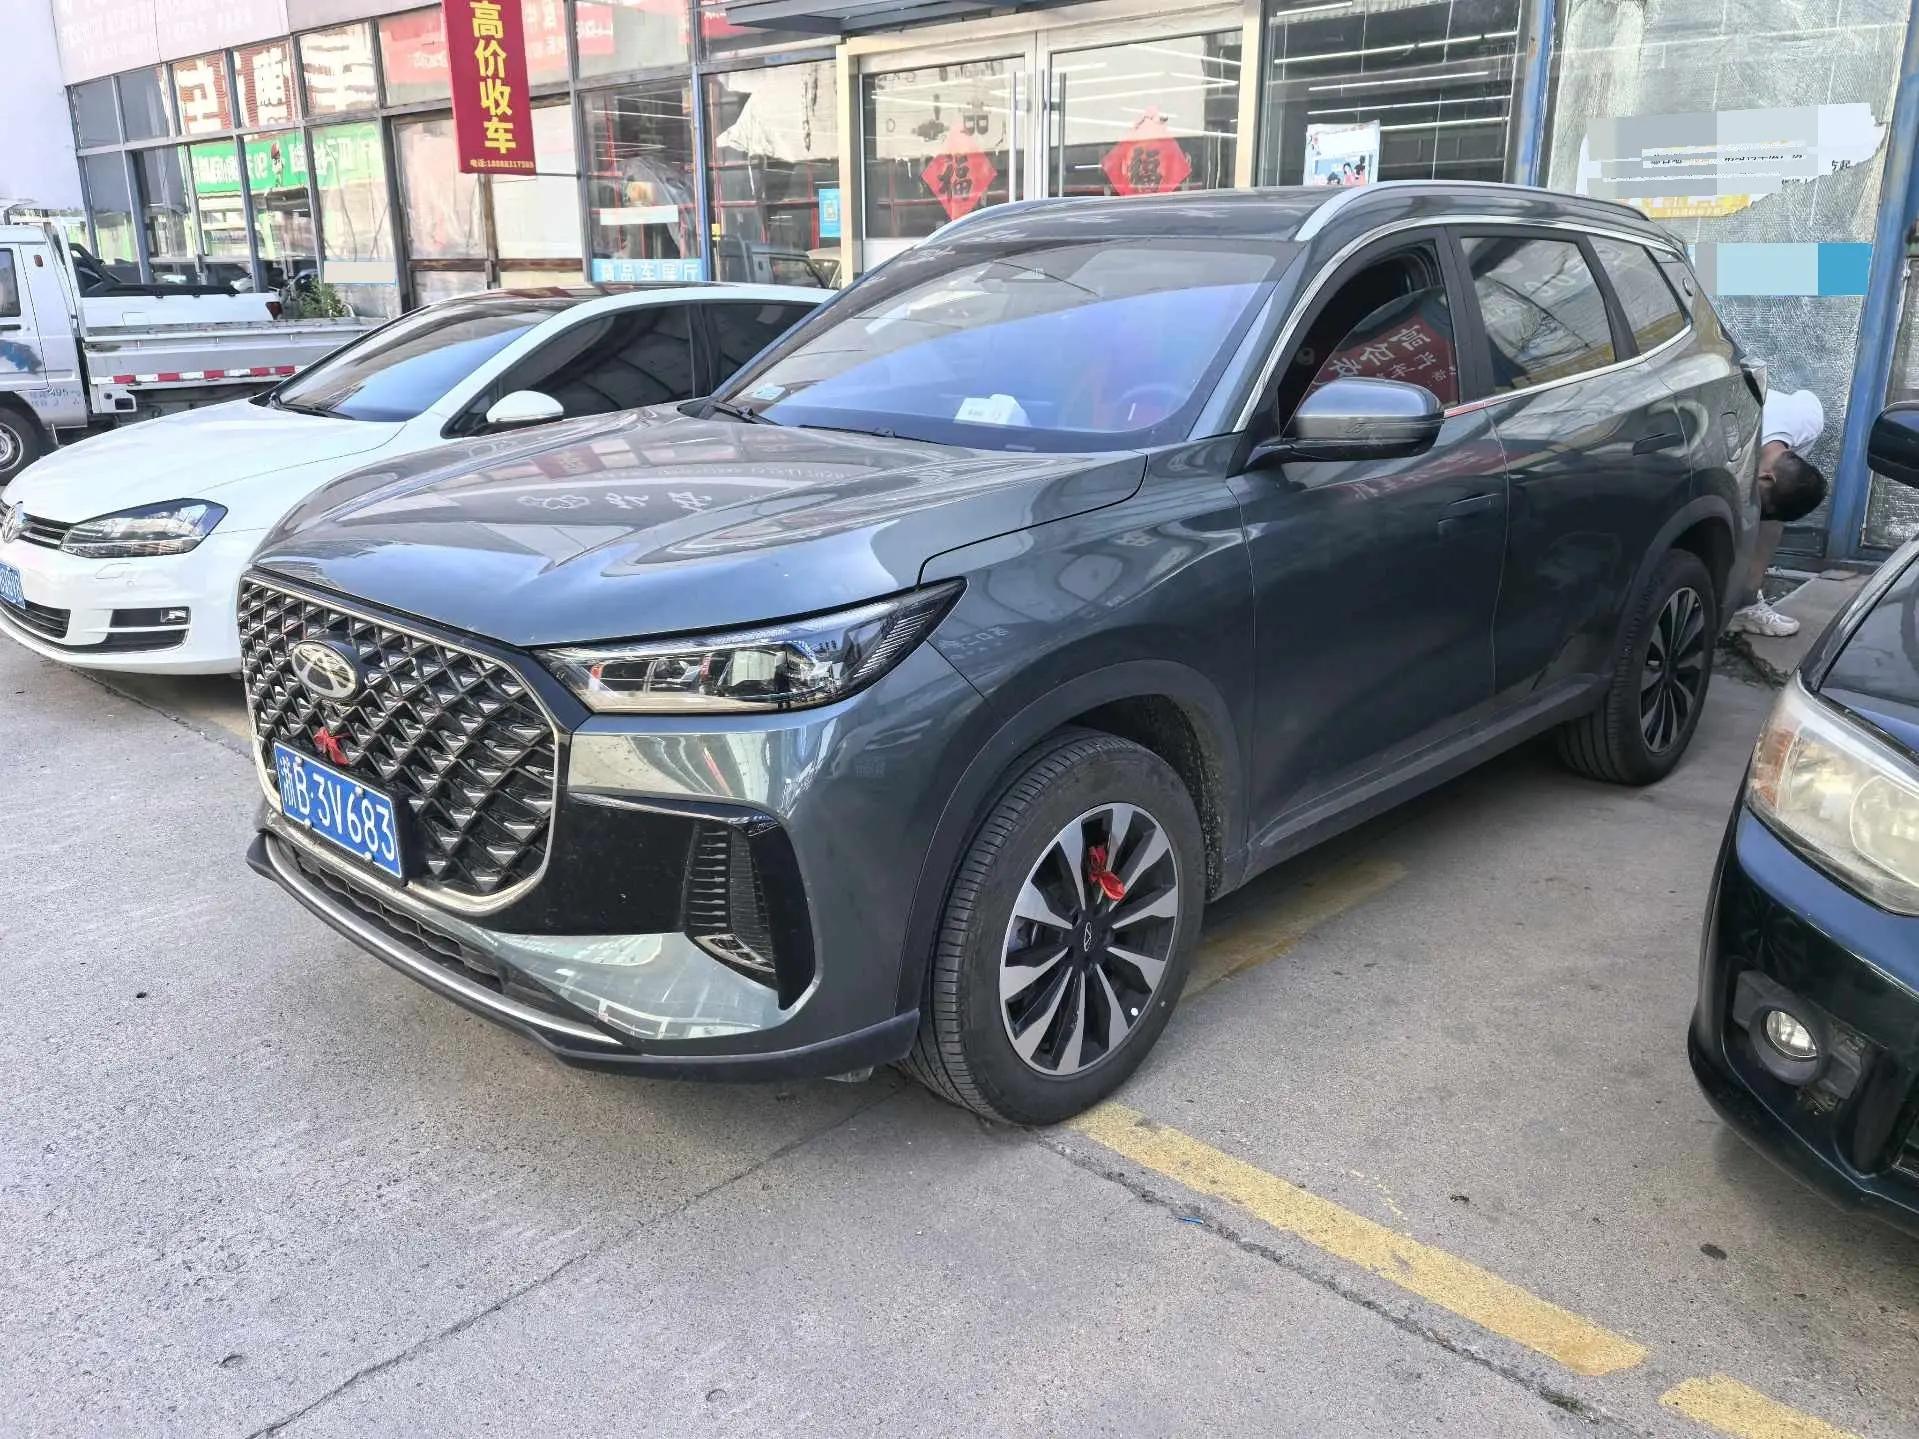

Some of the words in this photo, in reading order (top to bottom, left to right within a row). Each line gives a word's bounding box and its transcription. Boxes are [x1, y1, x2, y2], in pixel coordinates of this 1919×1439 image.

[469, 1, 517, 154] 高价收车
[936, 153, 973, 204] 福
